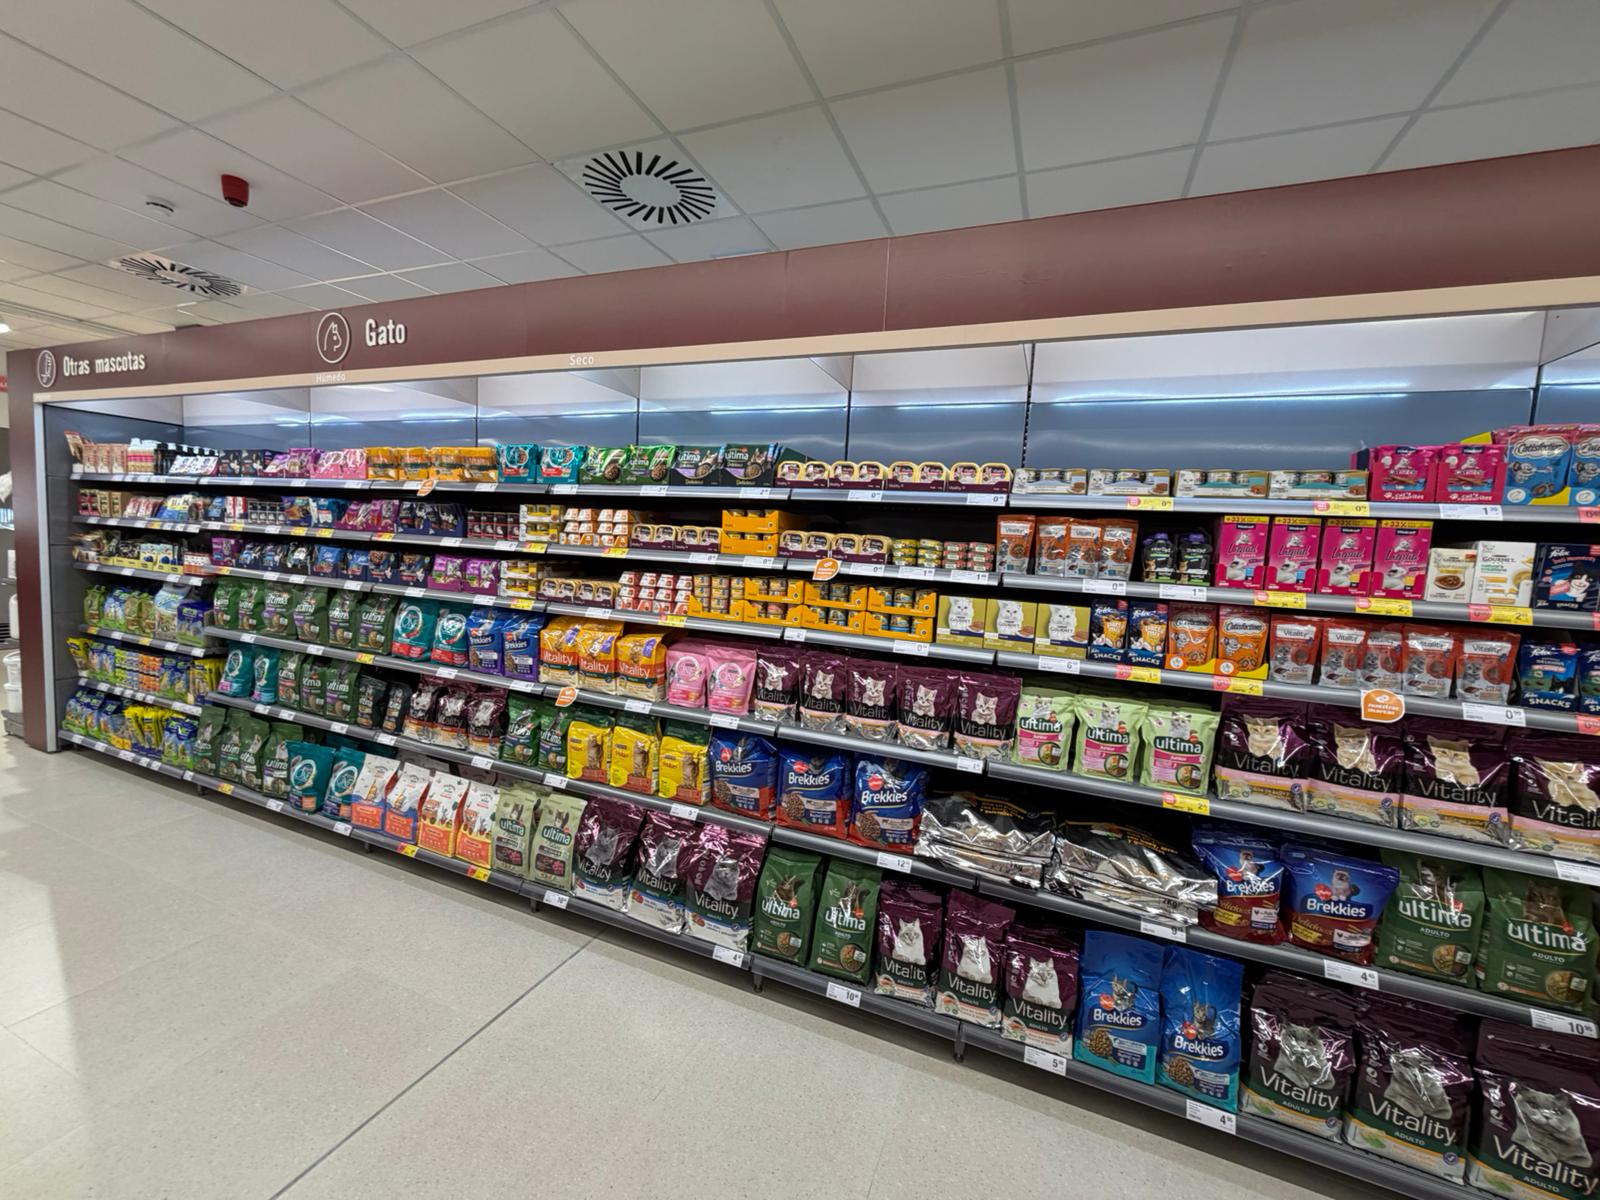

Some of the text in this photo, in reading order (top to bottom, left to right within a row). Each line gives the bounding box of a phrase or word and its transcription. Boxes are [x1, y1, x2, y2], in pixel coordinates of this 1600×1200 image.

[365, 318, 406, 346] Gato
[63, 352, 146, 376] Otras mascotas
[569, 355, 594, 366] Seco
[1093, 652, 1122, 662] SNACKS
[1131, 656, 1160, 666] SNACKS
[619, 661, 651, 679] Vitality
[1529, 698, 1572, 709] SNACKS
[960, 721, 1008, 741] Vitality
[1088, 727, 1129, 744] ultima
[1156, 736, 1202, 753] ultima
[716, 761, 752, 773] Brekkies
[1234, 752, 1299, 778] Vitality
[788, 772, 830, 785] Brekkies
[1322, 764, 1392, 794] Vitality
[861, 790, 908, 804] Brekkies
[1418, 778, 1497, 809] Vitality
[542, 827, 572, 845] ultima
[695, 889, 740, 920] Vitality
[1306, 897, 1367, 917] Brekkies
[1398, 899, 1473, 929] ultima
[1419, 926, 1451, 938] ADULTO
[1507, 921, 1588, 952] ultima
[1532, 951, 1565, 964] ADULTO
[948, 971, 997, 1002] Vitality
[1012, 996, 1068, 1027] Vitality
[1093, 1007, 1143, 1027] Brekkies
[1568, 1021, 1585, 1035] 10
[1173, 1034, 1224, 1057] Brekkies
[1259, 1065, 1340, 1114] Vitality
[1282, 1100, 1312, 1115] ADULTO
[1368, 1091, 1457, 1147] Vitality
[1393, 1130, 1427, 1146] ADULTO
[1492, 1134, 1600, 1197] Vitality
[1522, 1174, 1560, 1194] ADULTO
